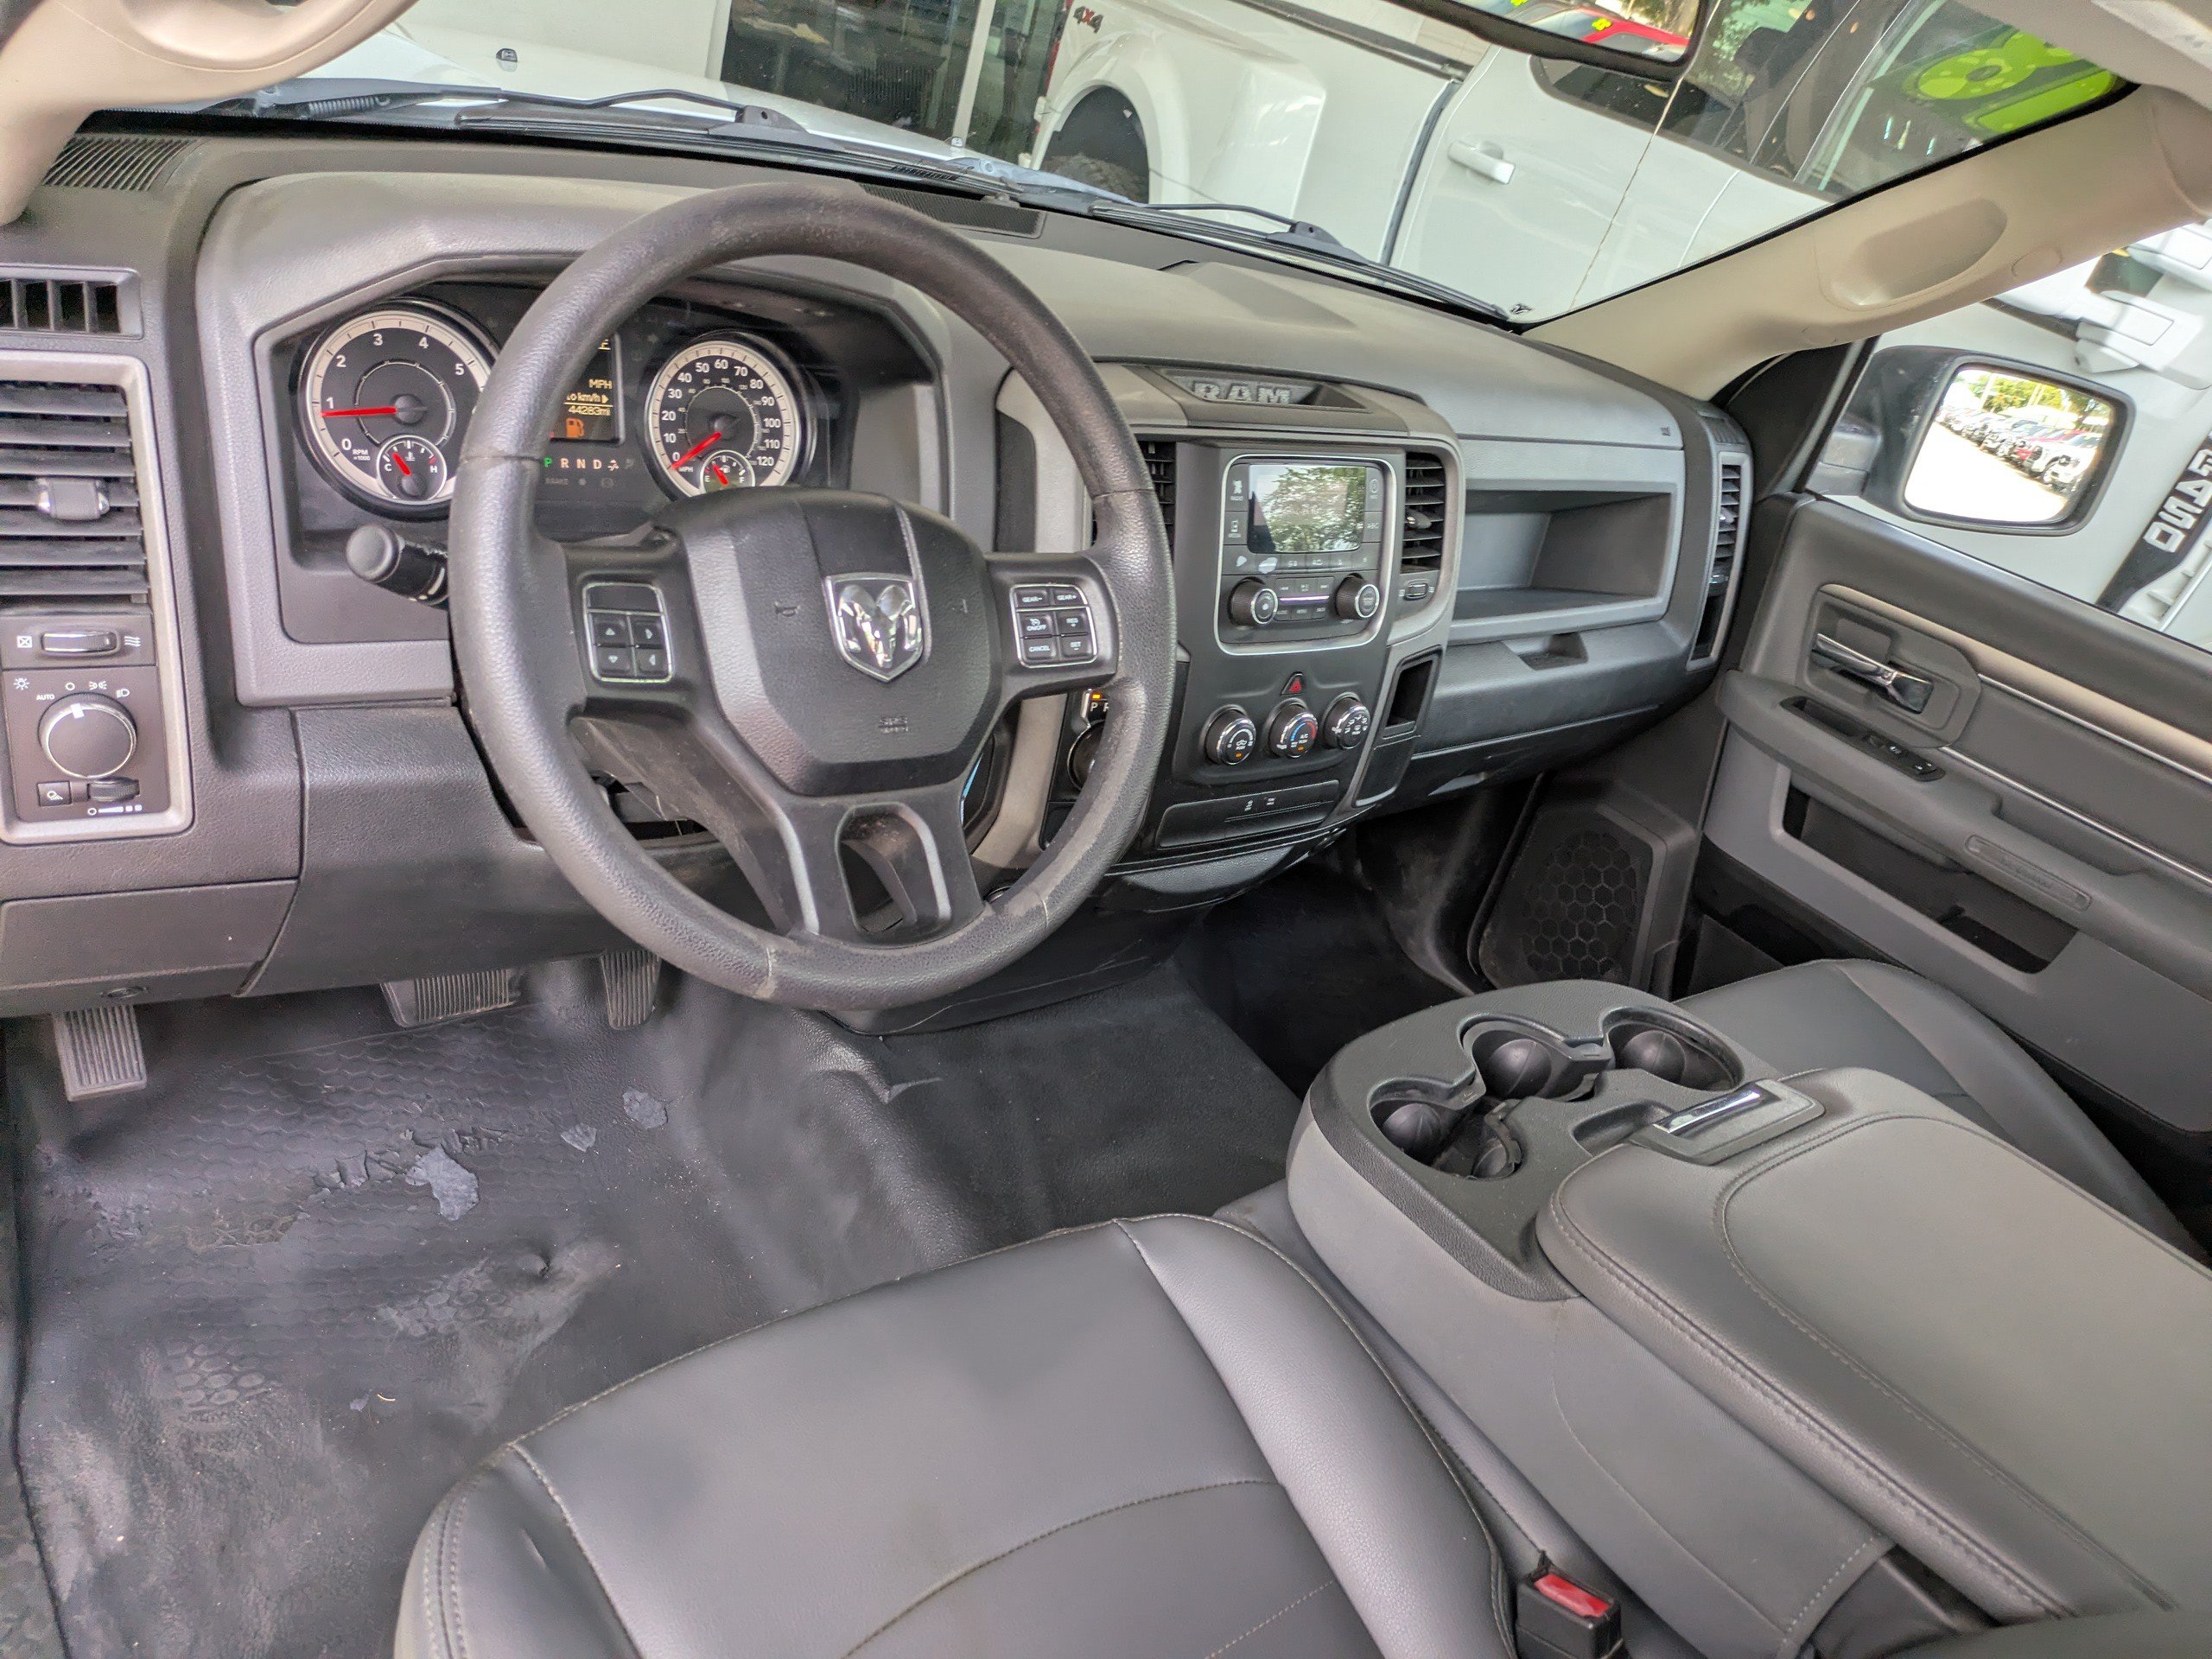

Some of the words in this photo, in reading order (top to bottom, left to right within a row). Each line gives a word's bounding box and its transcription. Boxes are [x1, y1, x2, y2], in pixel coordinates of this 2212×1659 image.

[373, 333, 384, 346] 3
[418, 336, 429, 349] 4
[336, 354, 346, 368] 2
[714, 359, 728, 370] 60
[454, 363, 465, 376] 5
[695, 362, 709, 373] 50
[734, 365, 748, 377] 70
[677, 372, 692, 383] 40
[588, 378, 613, 389] MPH
[749, 378, 764, 390] 80
[668, 388, 683, 399] 30
[1194, 382, 1291, 404] RAM
[326, 397, 334, 409] 1
[761, 396, 775, 407] 90
[661, 410, 676, 421] 20
[763, 417, 781, 428] 100
[664, 433, 677, 443] 10
[764, 439, 780, 448] 110
[340, 438, 352, 450] 0
[672, 451, 680, 461] 0
[756, 455, 774, 466] 120
[543, 457, 552, 467] P
[560, 458, 569, 468] R
[576, 458, 586, 468] N
[593, 459, 602, 469] D
[1090, 702, 1098, 712] P
